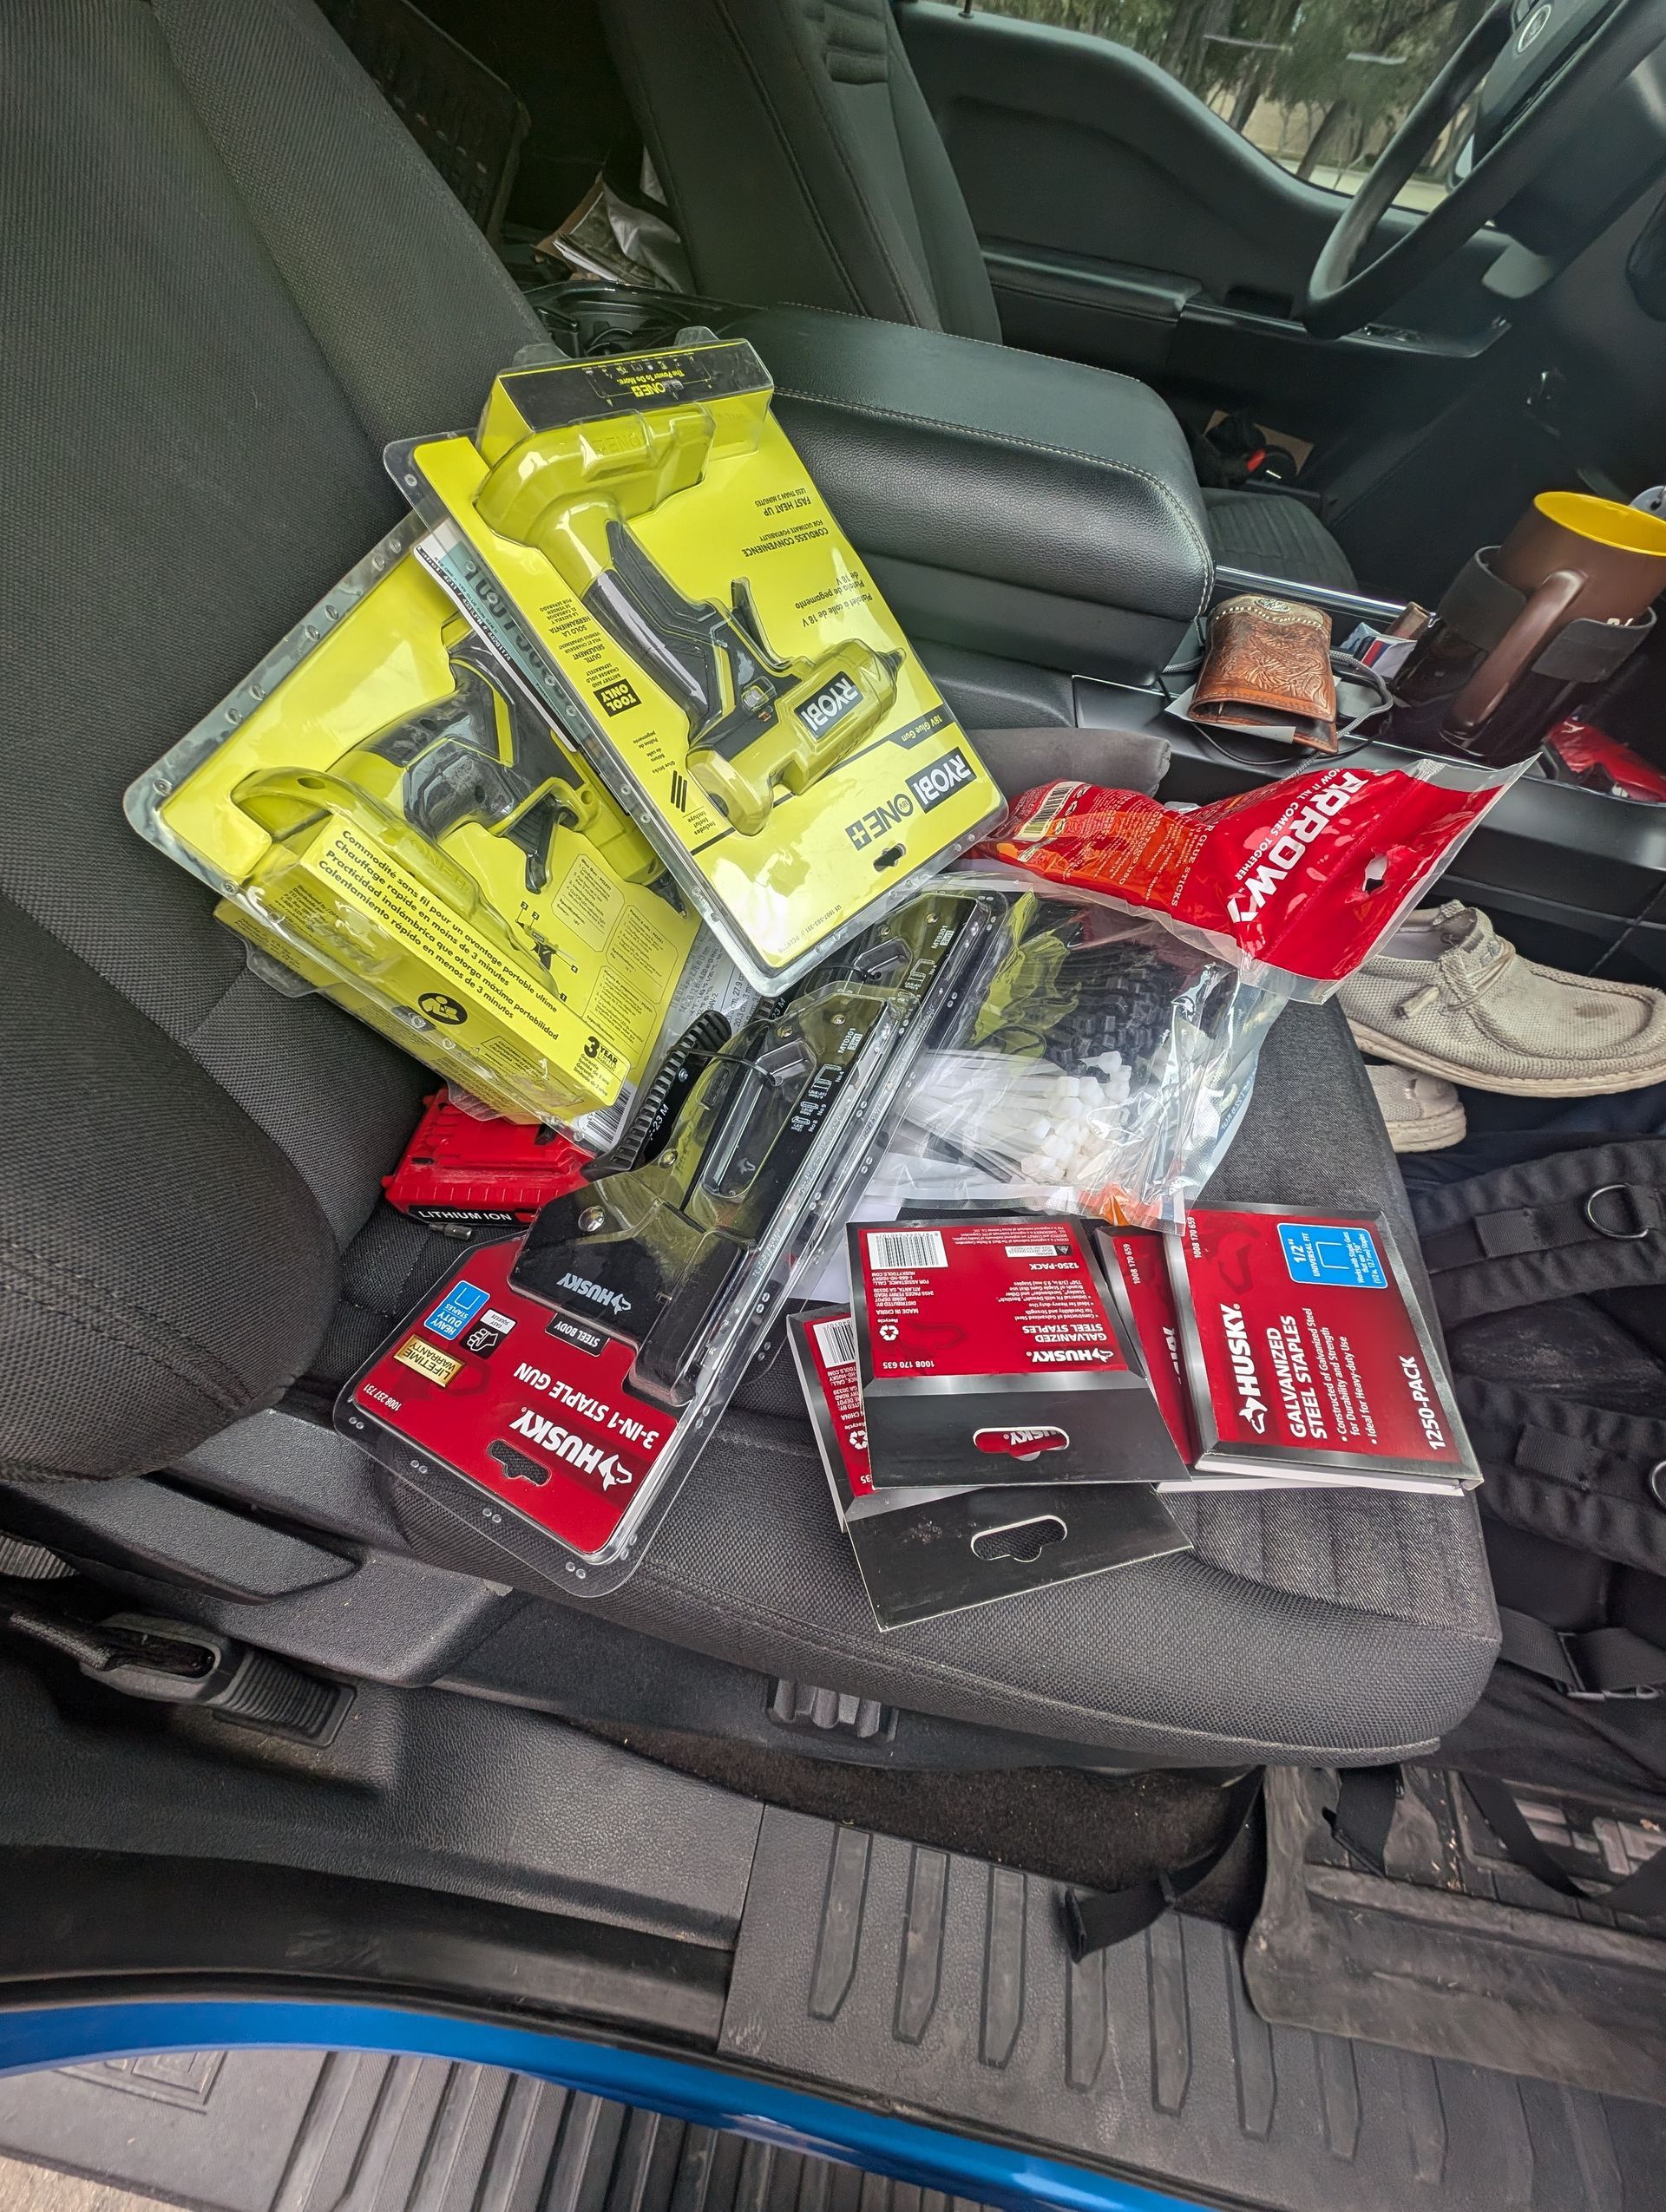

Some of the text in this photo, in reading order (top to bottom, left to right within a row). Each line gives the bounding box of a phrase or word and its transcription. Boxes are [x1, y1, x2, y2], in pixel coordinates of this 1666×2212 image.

[653, 370, 672, 380] Power
[672, 369, 684, 377] The
[762, 494, 811, 517] FAST HEAT UP
[789, 521, 813, 534] ULTIMATE
[811, 518, 823, 528] FOR
[741, 526, 829, 558] CORDLESS CONVENIENCE
[793, 579, 865, 612] Pistola de pegamento
[848, 592, 873, 607] Pistolet
[806, 613, 818, 625] 18
[817, 609, 829, 620] de
[826, 602, 844, 616] colle
[548, 614, 590, 635] HERRAMIENTA
[561, 623, 587, 638] SOLO LA
[799, 617, 810, 627] V
[571, 643, 605, 660] SEULEMENT
[583, 651, 601, 664] OUTIL
[599, 681, 628, 703] ONLY
[605, 691, 636, 713] TOOL
[799, 677, 859, 732] RYOBI
[899, 712, 943, 743] 18V Glue Gun
[910, 753, 972, 806] RYOBI
[1309, 781, 1322, 791] IT
[1295, 786, 1313, 802] ALL
[692, 820, 716, 836] Includes
[1269, 800, 1301, 836] COMES
[1242, 769, 1368, 909] ARROW
[1233, 835, 1273, 881] TOGETHER
[1168, 832, 1209, 908] GLUE STICKS
[331, 836, 512, 987] Chauffage rapide en moins de 3 minutes
[339, 828, 561, 1013] Commodité sans fil pour un avantage portable ultime
[317, 858, 392, 921] Calentamiento
[389, 916, 425, 947] rápido
[420, 942, 436, 957] en
[433, 952, 466, 980] menos
[462, 974, 478, 990] de
[474, 985, 485, 995] 3
[482, 989, 517, 1019] minutos
[325, 848, 384, 899] Practicidad
[379, 893, 438, 943] inalámbrica
[433, 939, 456, 959] que
[451, 952, 484, 981] otorga
[481, 975, 517, 1005] máxima
[512, 1001, 561, 1041] portabilidad
[930, 923, 948, 950] MT0301
[731, 979, 742, 997] 27.9
[579, 1034, 620, 1065] 3 YEAR
[836, 1025, 856, 1054] MT0301
[418, 1209, 512, 1221] LITHIUM ION
[1186, 1215, 1202, 1259] 1008 170 659
[1301, 1231, 1321, 1277] UNIVERSAL FIT
[1345, 1242, 1356, 1257] Staple
[1028, 1261, 1079, 1270] 1250-PACK
[1123, 1242, 1141, 1284] 1008 170 659
[1349, 1257, 1360, 1268] with
[1354, 1267, 1365, 1283] Works
[555, 1269, 615, 1306] HUSKY
[436, 1309, 462, 1328] DUTY
[443, 1302, 469, 1319] STAPLES
[490, 1312, 509, 1325] SQUEEZE
[430, 1316, 456, 1336] HEAVY
[489, 1319, 502, 1329] EASY
[553, 1319, 600, 1348] STEEL BODY
[1021, 1323, 1103, 1333] STEEL STAPLES
[1033, 1332, 1106, 1342] GALVANIZED
[401, 1346, 451, 1380] LIFETIME
[408, 1339, 456, 1372] WARRANTY
[1280, 1312, 1328, 1441] STEEL STAPLES
[1302, 1306, 1348, 1435] Constructed of Galvanized Steel
[1320, 1325, 1361, 1436] for Durability and Strength
[1265, 1325, 1308, 1439] GALVANIZED
[1337, 1335, 1377, 1437] Ideal for Heavy-duty Use
[362, 1382, 403, 1412] 1008 237 731
[512, 1359, 660, 1450] 3-IN-1 STAPLE GUN
[835, 1397, 854, 1405] DEPOT
[1399, 1352, 1446, 1450] 1250-PACK
[840, 1410, 860, 1420] CHINA
